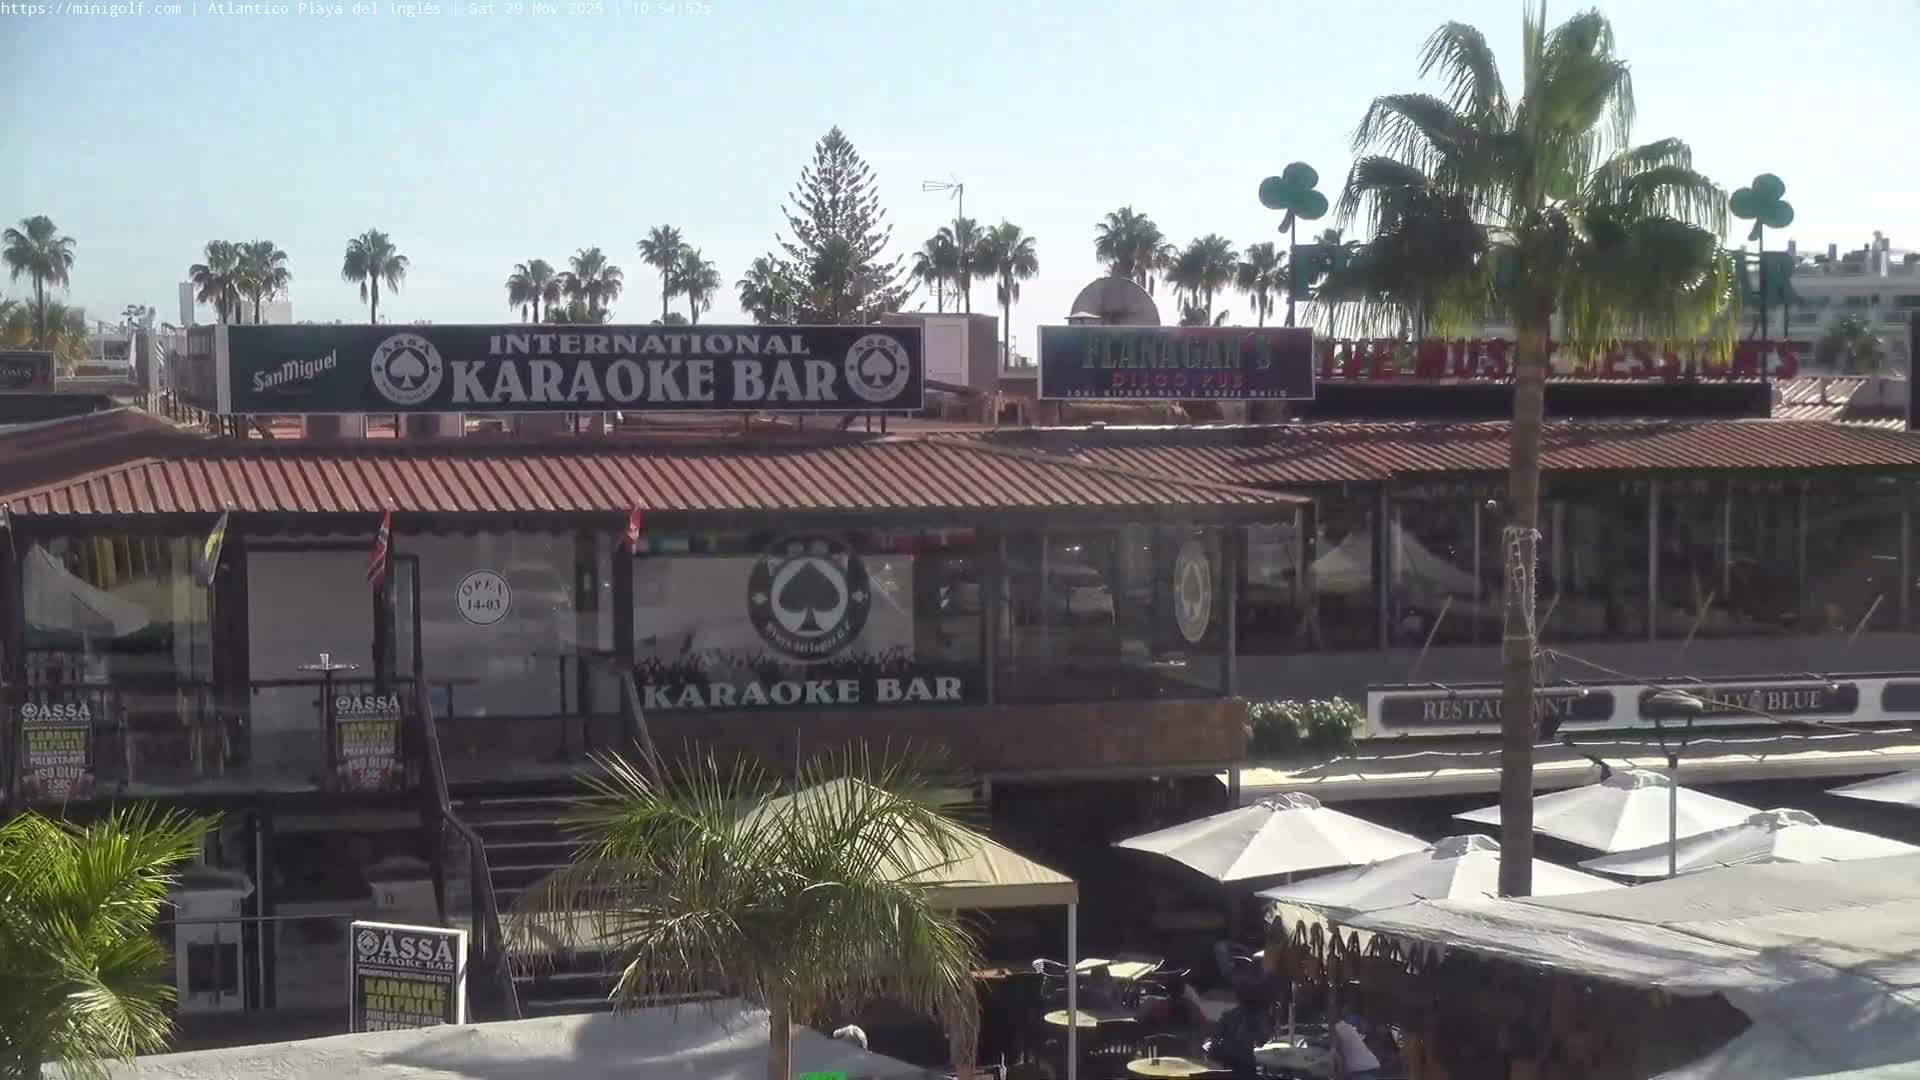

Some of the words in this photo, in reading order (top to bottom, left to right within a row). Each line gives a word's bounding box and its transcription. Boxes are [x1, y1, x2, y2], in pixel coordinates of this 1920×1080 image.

[489, 333, 810, 355] INTERNATIONAL
[451, 359, 717, 404] KARAOKE
[731, 359, 840, 402] BAR
[643, 679, 861, 710] KARAOKE
[877, 676, 963, 703] BAR
[1767, 690, 1821, 711] BLUE
[380, 929, 454, 963] ÄSSÄ
[359, 955, 423, 968] KARAOKE
[426, 960, 454, 970] BAR
